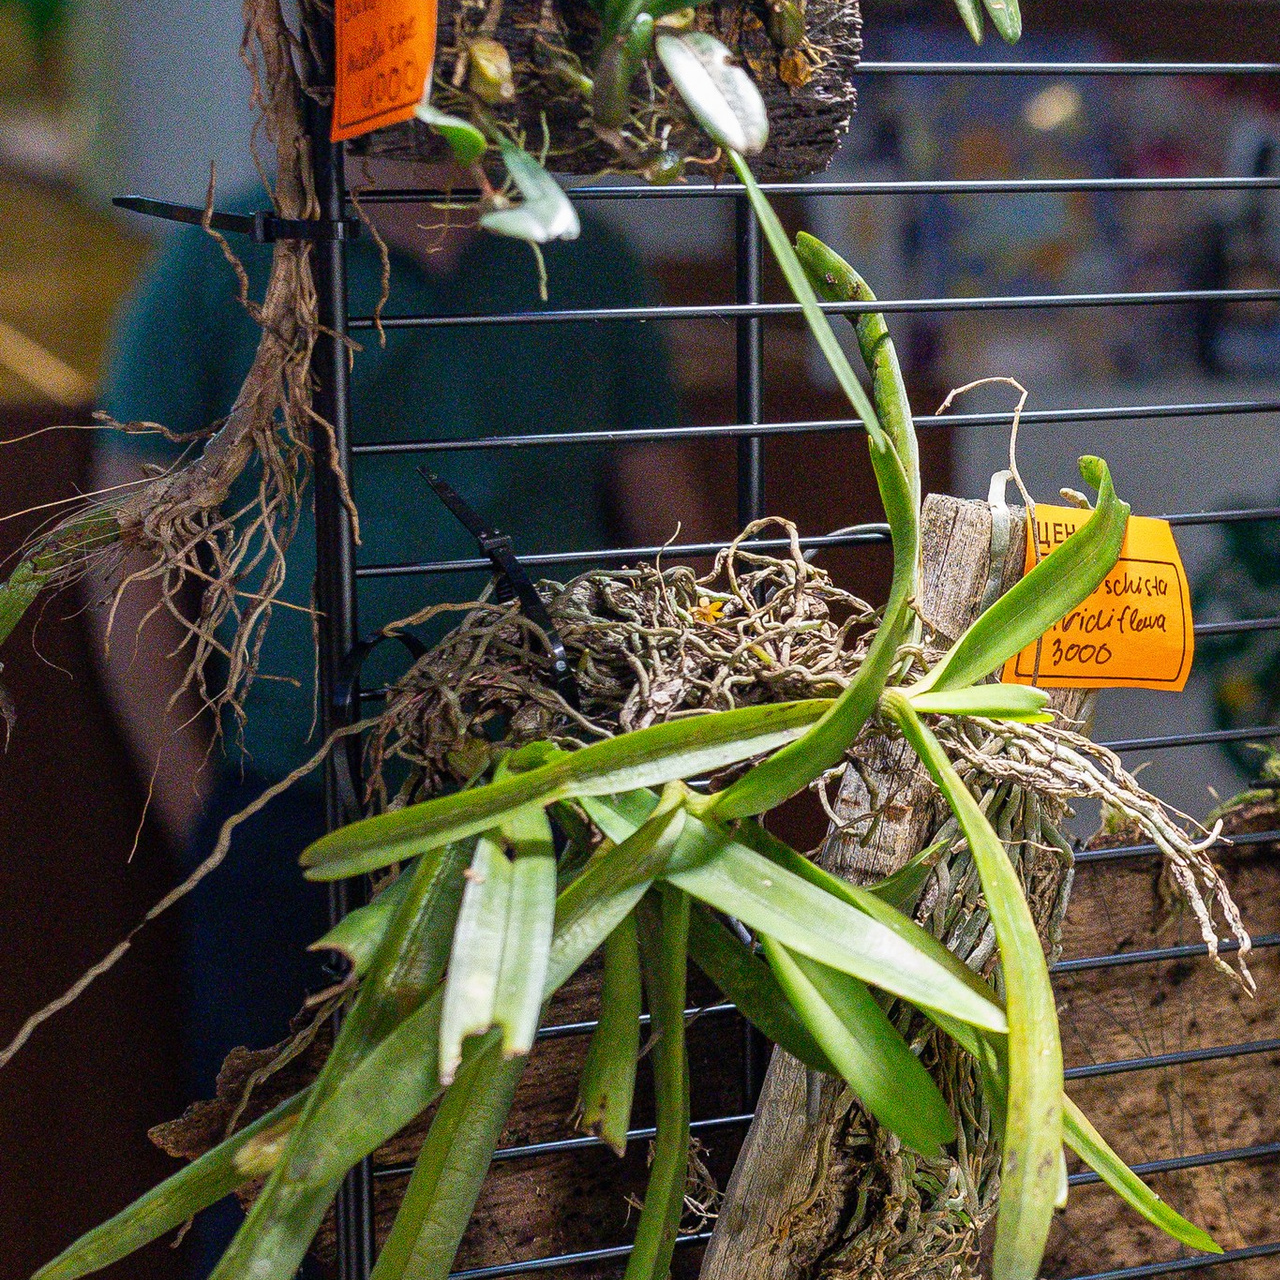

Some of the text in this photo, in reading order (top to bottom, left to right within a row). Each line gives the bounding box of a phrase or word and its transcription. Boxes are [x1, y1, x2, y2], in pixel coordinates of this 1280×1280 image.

[1037, 521, 1076, 548] ЦЕН
[1093, 572, 1168, 597] schista
[1052, 638, 1112, 667] 3000
